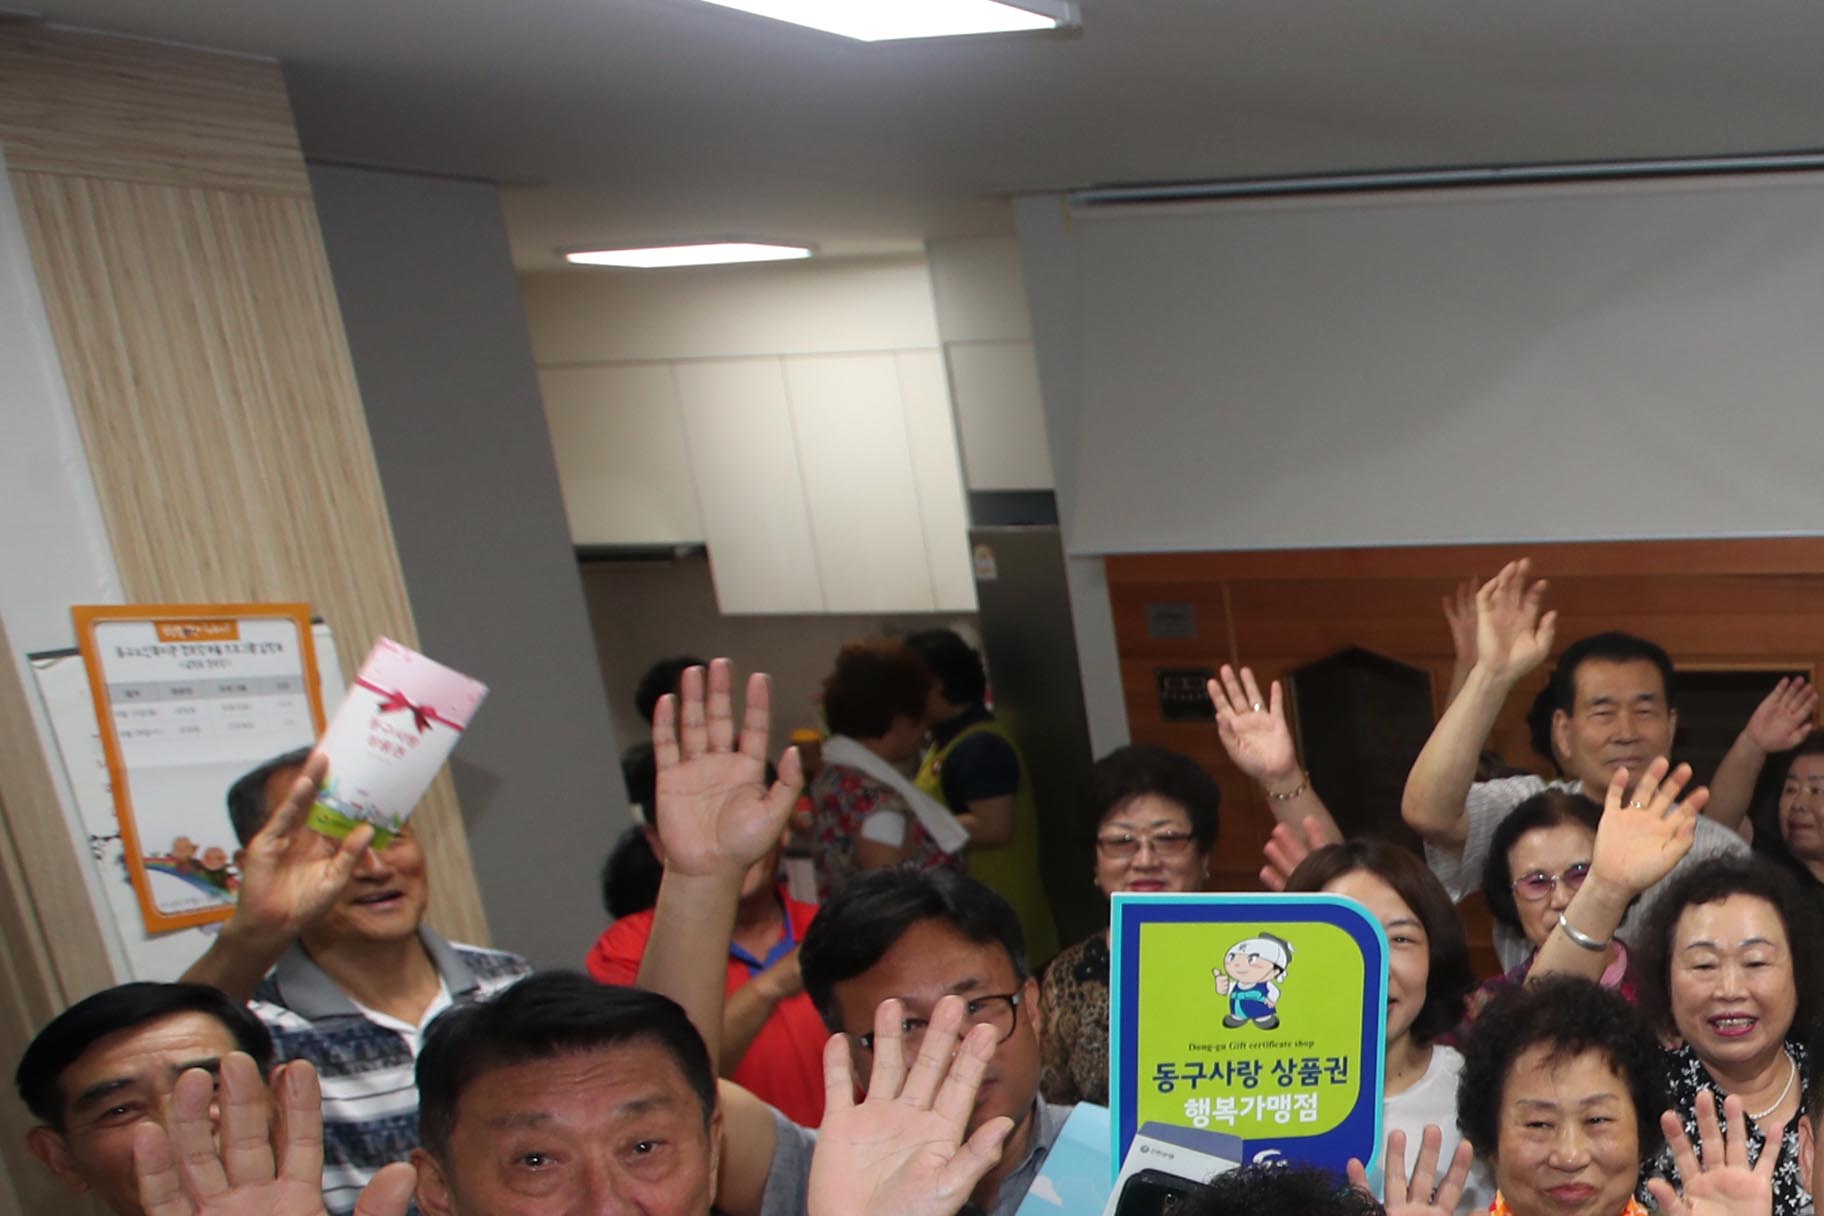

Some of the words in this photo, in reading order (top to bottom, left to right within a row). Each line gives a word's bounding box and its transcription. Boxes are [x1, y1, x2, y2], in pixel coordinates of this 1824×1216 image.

[1188, 1042, 1226, 1053] Dong-gu
[1228, 1040, 1247, 1051] Gift
[1248, 1038, 1292, 1050] certificate
[1294, 1038, 1315, 1050] shop
[1152, 1058, 1263, 1094] 동구사랑
[1270, 1055, 1350, 1088] 상품권
[1183, 1091, 1319, 1129] 행복가맹점
